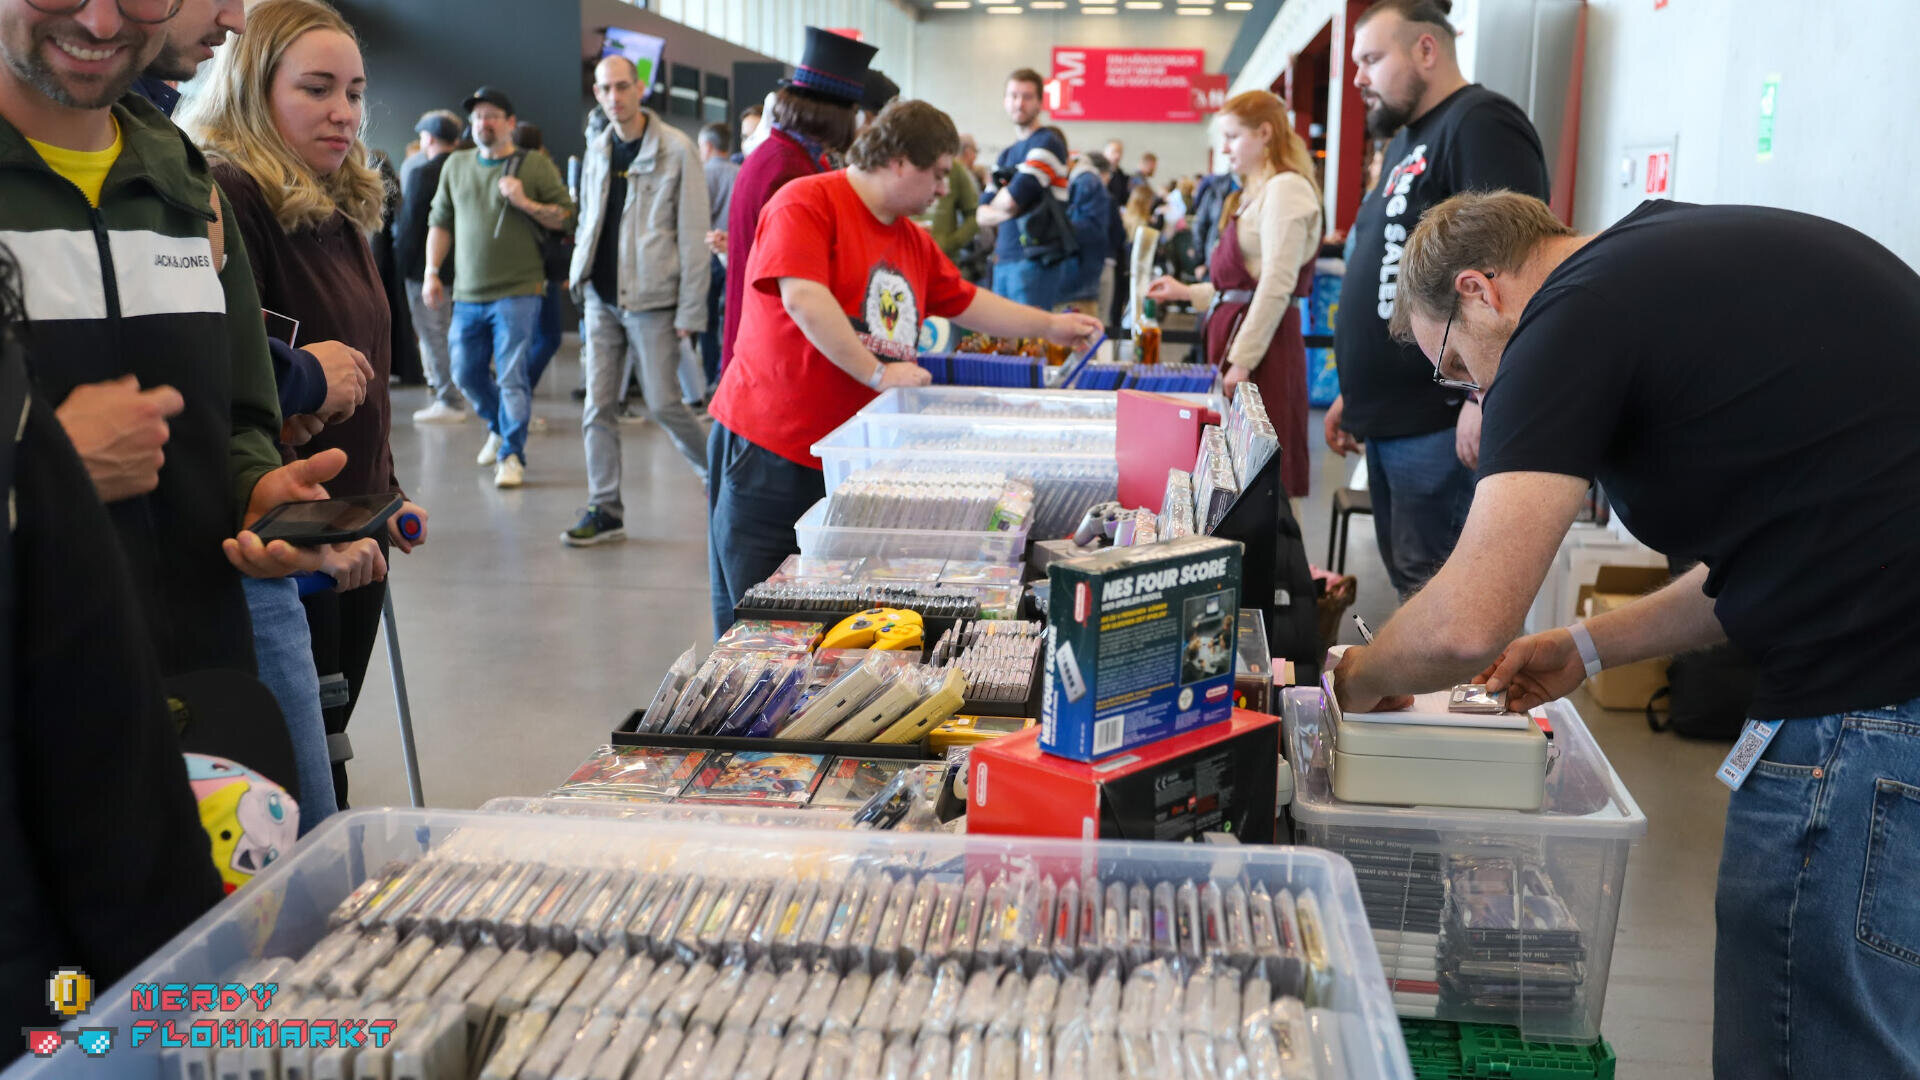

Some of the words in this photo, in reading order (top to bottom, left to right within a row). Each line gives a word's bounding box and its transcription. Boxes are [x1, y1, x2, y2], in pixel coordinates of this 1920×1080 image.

[1377, 223, 1408, 320] SALES
[1102, 576, 1134, 602] NES
[1135, 568, 1179, 595] FOUR
[1179, 557, 1229, 585] SCORE
[1046, 624, 1057, 673] SCORE
[1043, 671, 1054, 714] FOUR
[1041, 712, 1051, 745] NES
[1349, 838, 1372, 846] MEDAL
